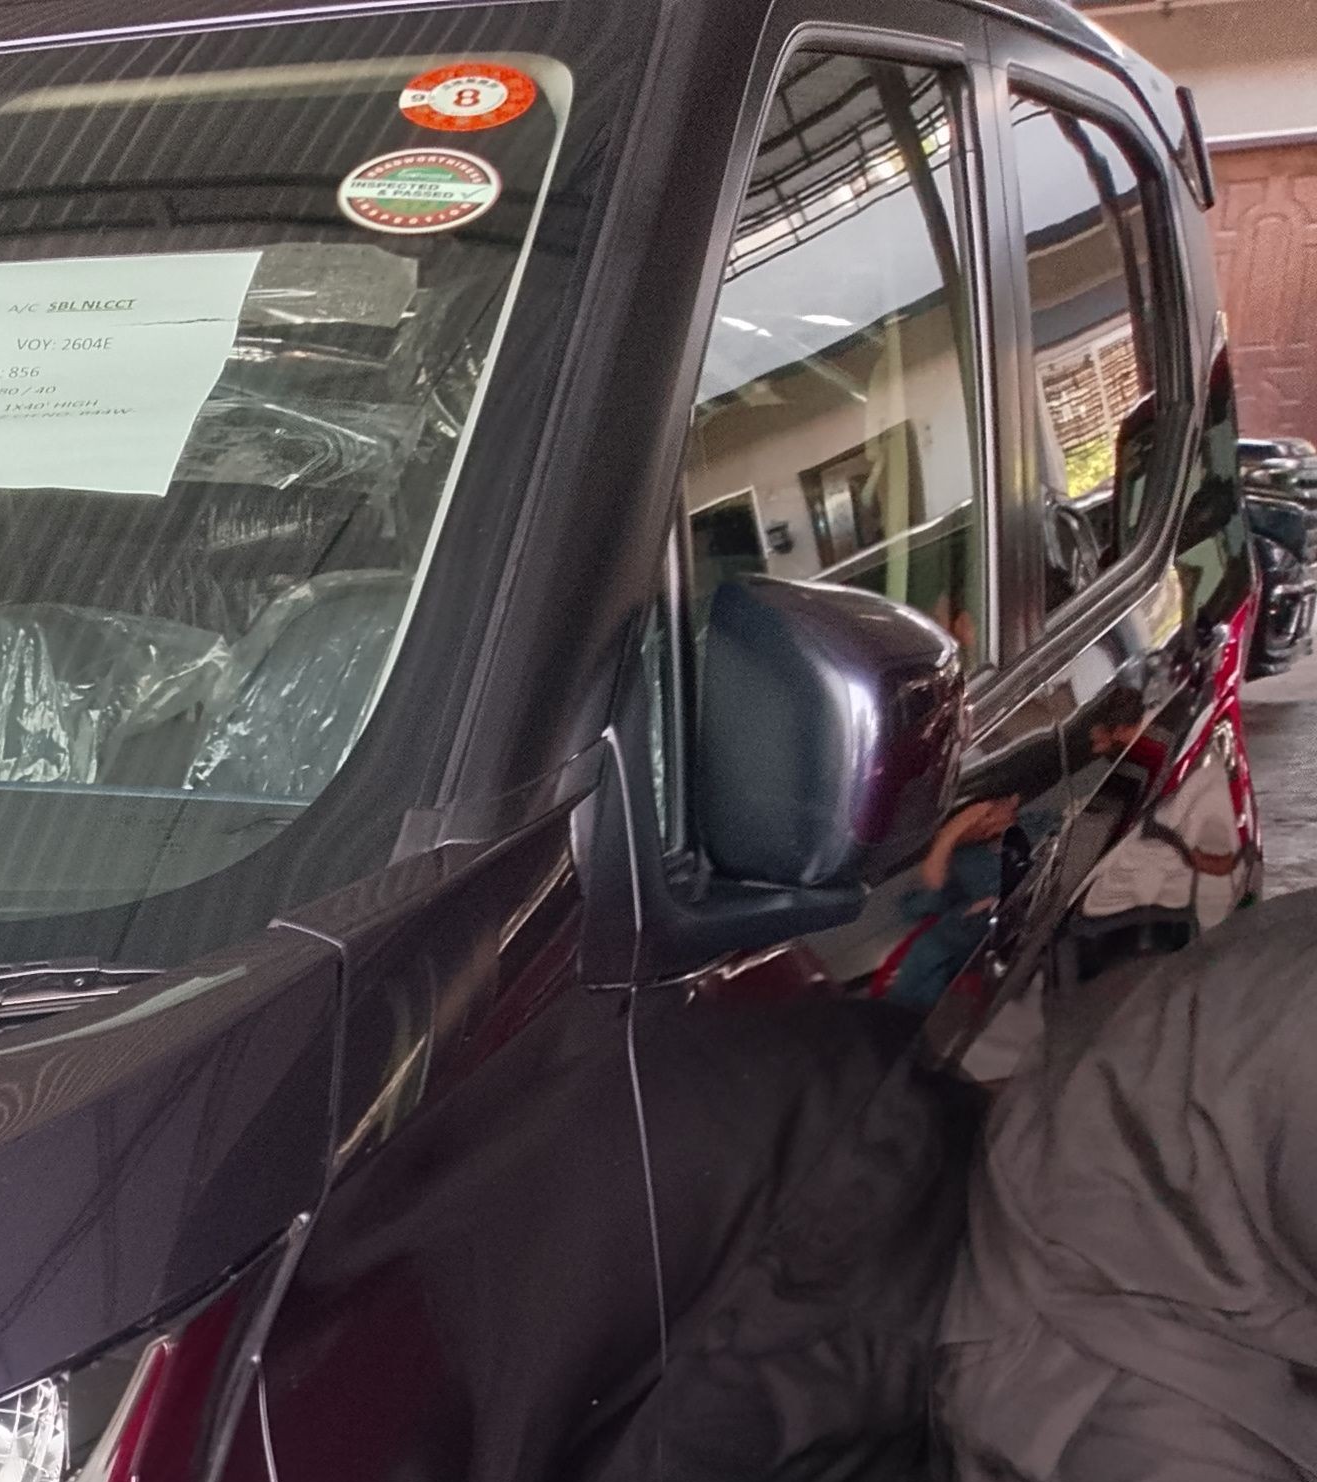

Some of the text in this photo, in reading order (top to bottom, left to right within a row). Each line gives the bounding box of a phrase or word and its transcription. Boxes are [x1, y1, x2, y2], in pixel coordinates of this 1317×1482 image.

[453, 89, 480, 107] 8
[351, 181, 439, 190] INSPECTED
[393, 190, 454, 199] PASSED
[17, 338, 57, 352] VOY:
[62, 337, 113, 351] 2604E
[9, 366, 40, 379] 856
